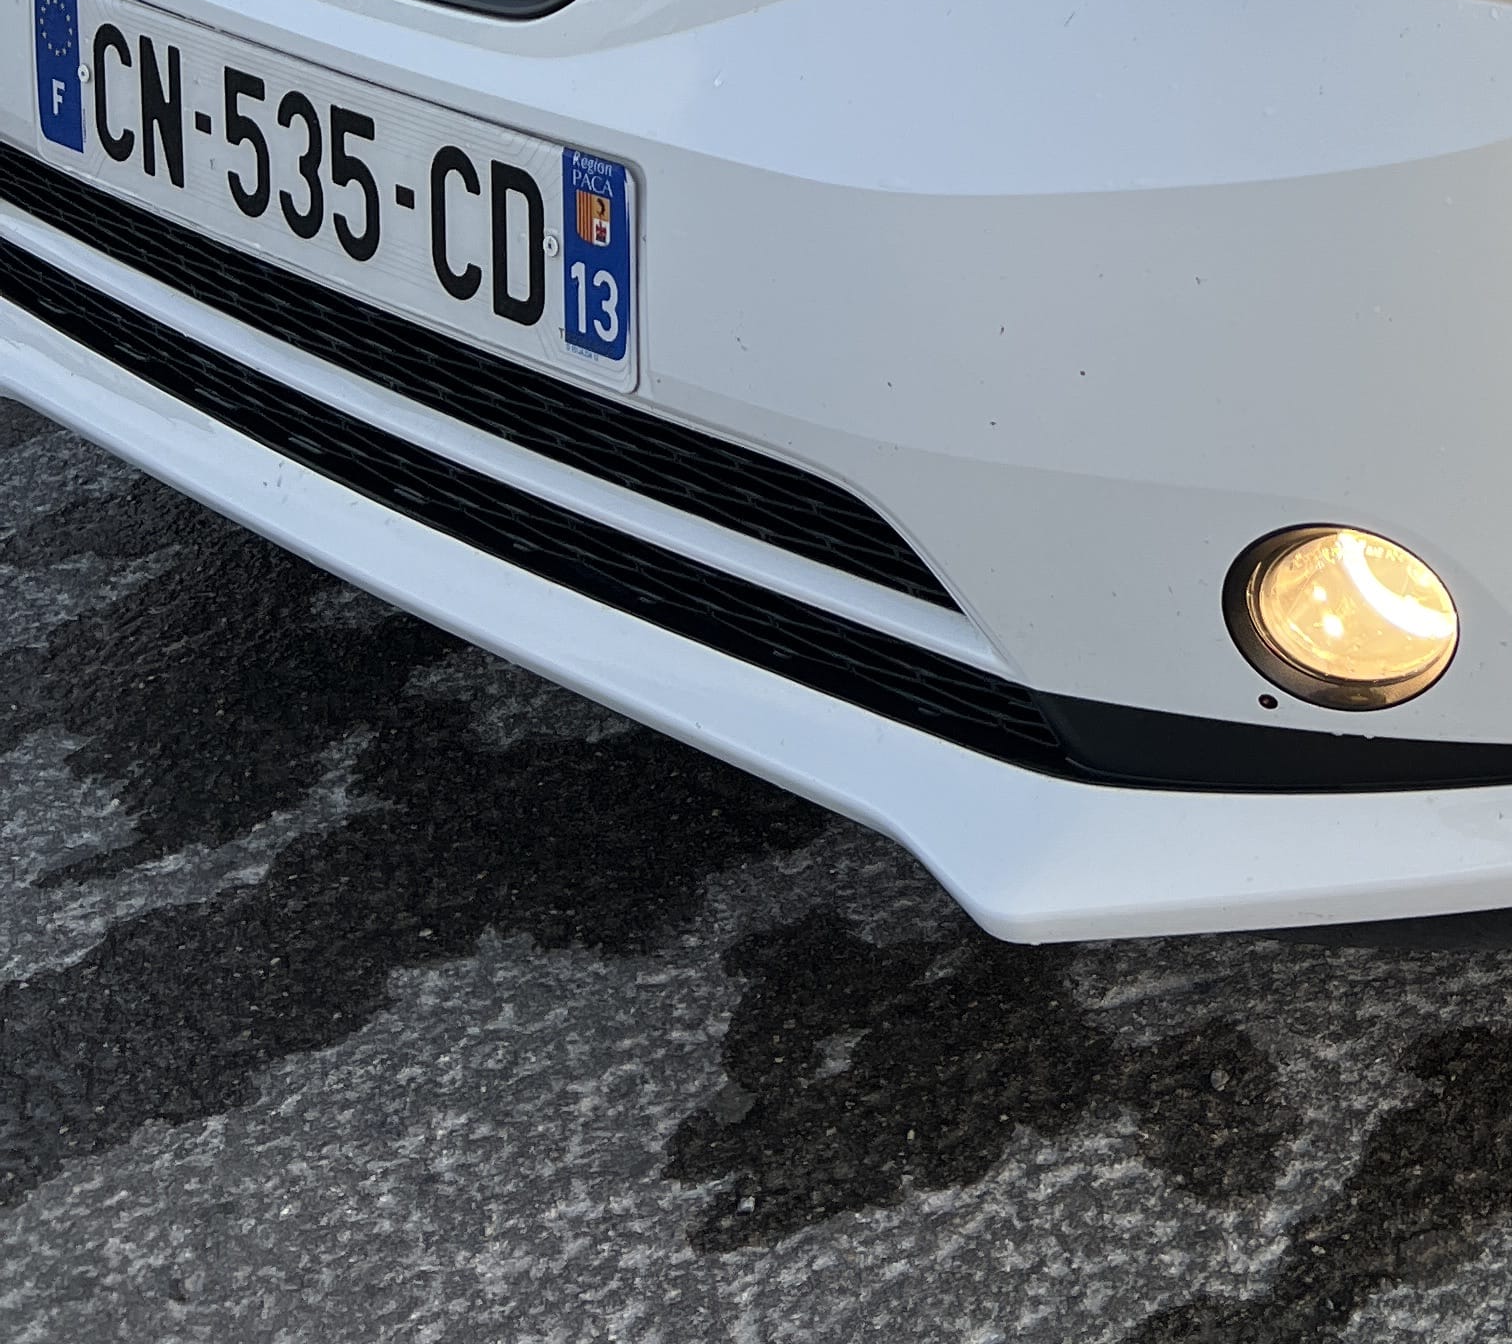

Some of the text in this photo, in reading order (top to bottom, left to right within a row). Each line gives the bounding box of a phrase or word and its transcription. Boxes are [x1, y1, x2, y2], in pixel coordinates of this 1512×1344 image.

[51, 78, 66, 116] F
[94, 23, 546, 326] CN-535-CD
[572, 150, 613, 176] Region
[572, 168, 614, 198] PACA
[570, 261, 619, 343] 13
